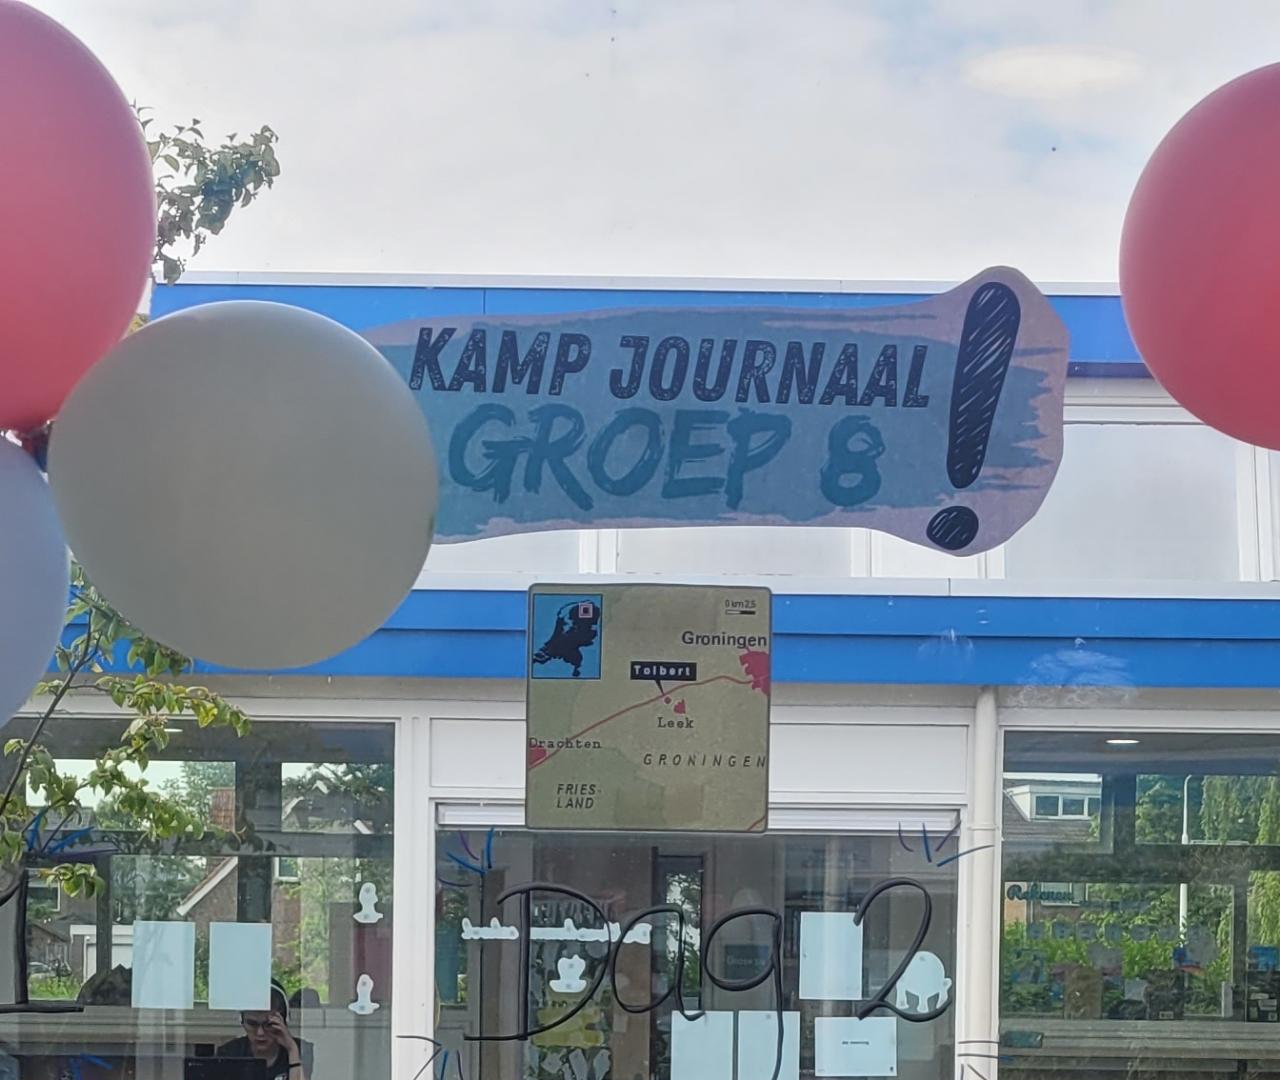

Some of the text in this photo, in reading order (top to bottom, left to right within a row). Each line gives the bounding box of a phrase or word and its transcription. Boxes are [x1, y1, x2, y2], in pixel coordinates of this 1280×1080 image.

[410, 327, 929, 408] KAMP JOURNAAL
[447, 402, 886, 510] GROEP 8
[681, 631, 768, 649] Groningen
[633, 664, 692, 677] Tolbert
[657, 716, 695, 729] Leek
[528, 737, 603, 750] Drachten
[643, 753, 767, 769] GRONINGEN
[556, 783, 603, 796] FRIES-
[557, 798, 596, 810] LAND
[854, 876, 954, 1022] 2
